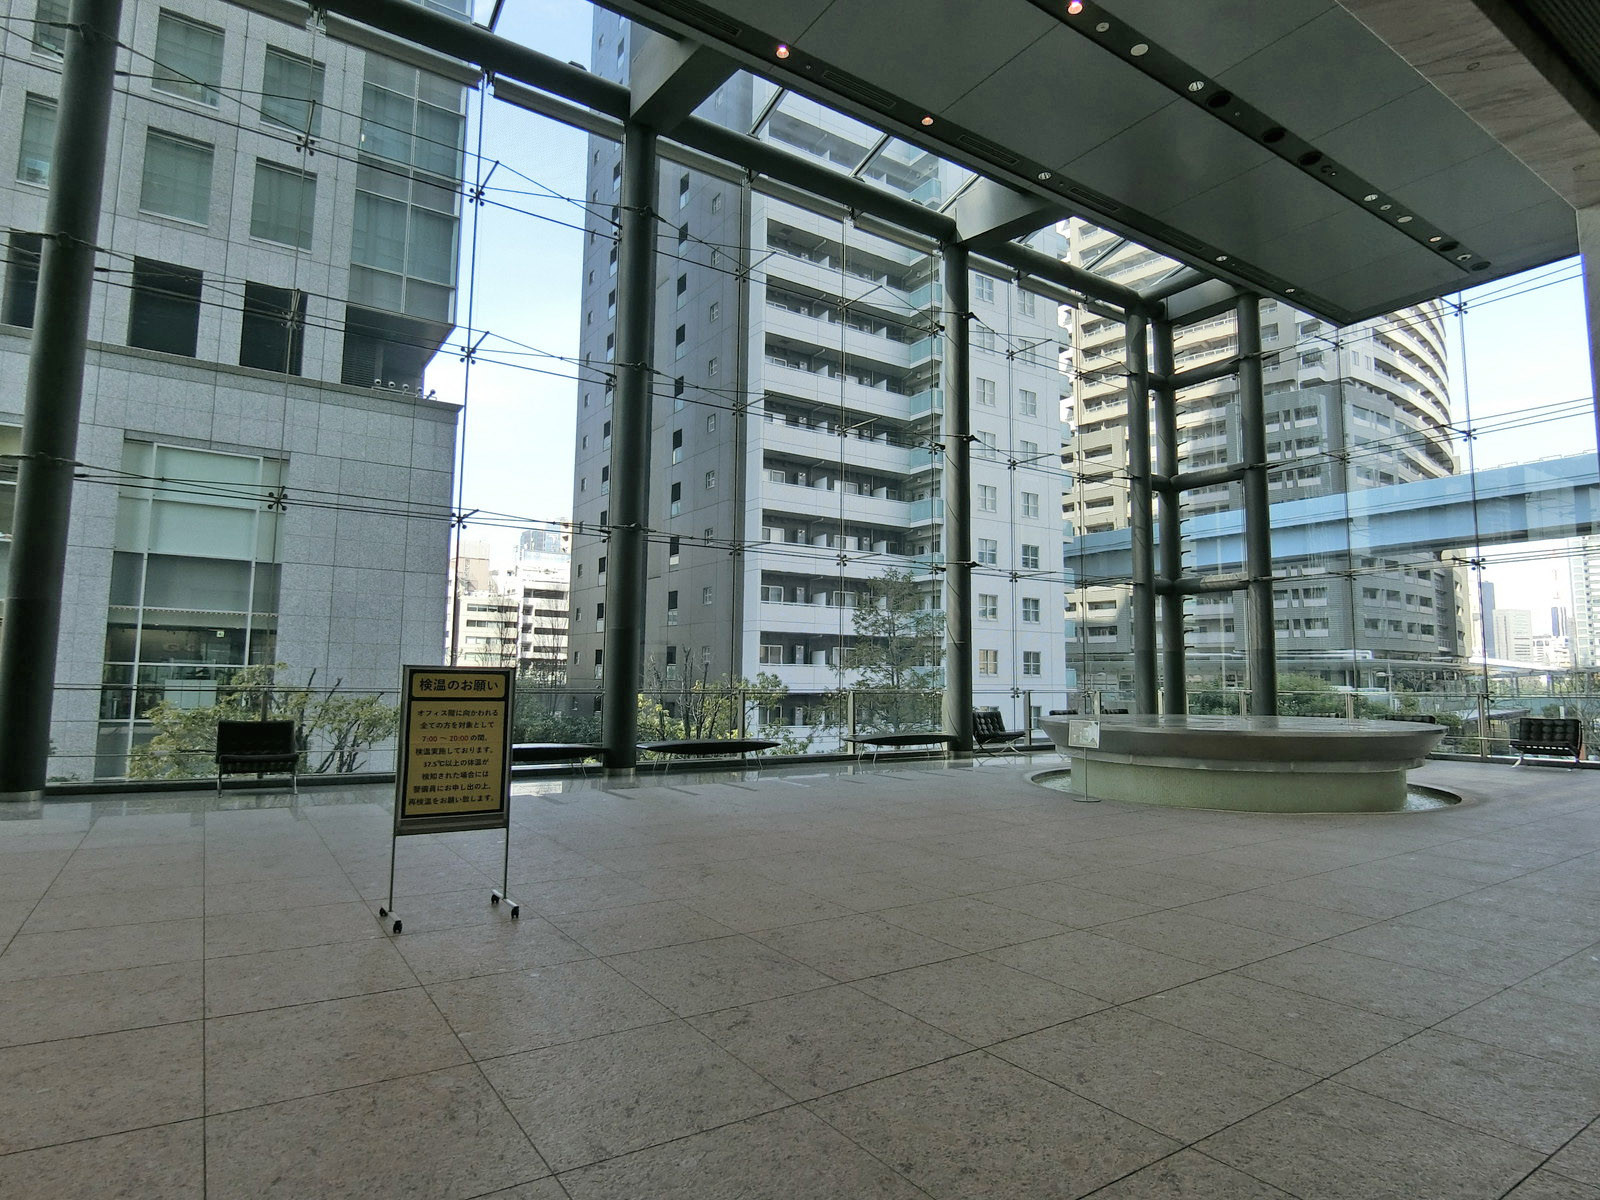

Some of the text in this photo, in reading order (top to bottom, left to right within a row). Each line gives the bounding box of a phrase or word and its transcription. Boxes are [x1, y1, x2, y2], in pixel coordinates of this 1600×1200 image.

[419, 678, 499, 692] 検温のお願い
